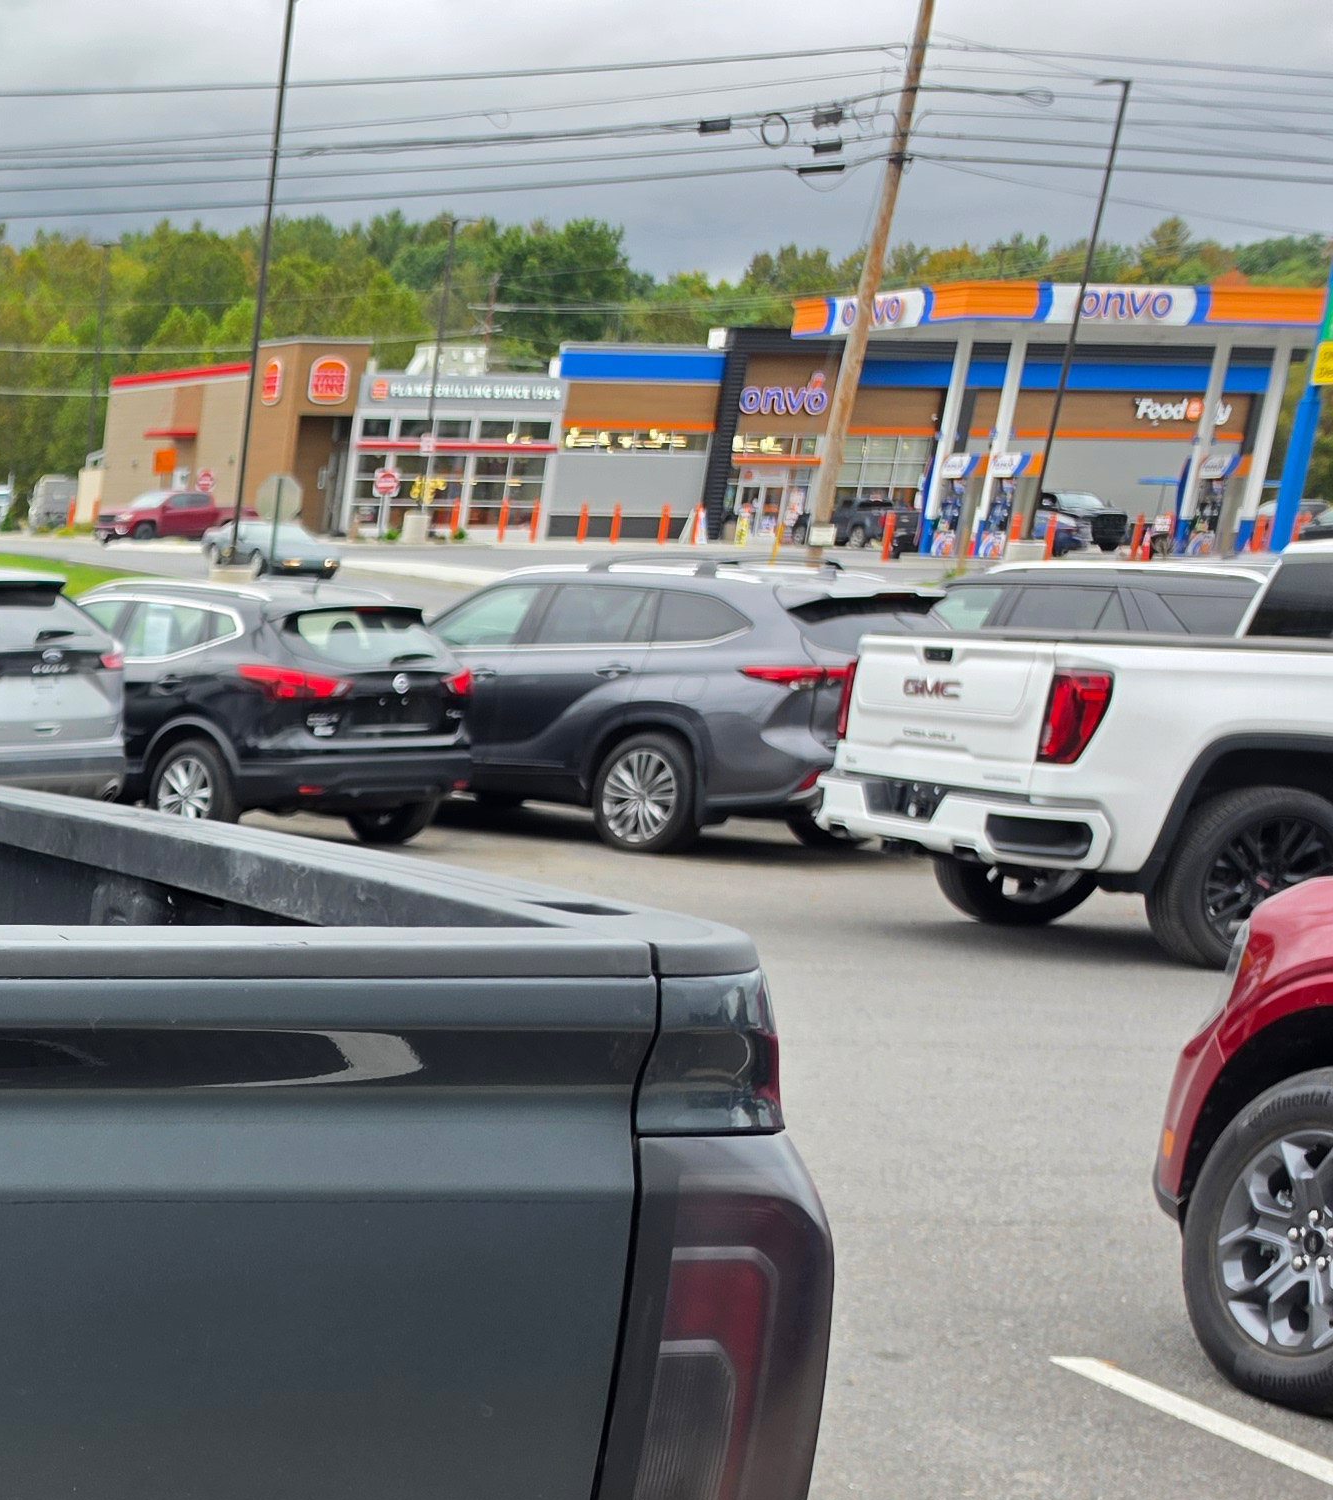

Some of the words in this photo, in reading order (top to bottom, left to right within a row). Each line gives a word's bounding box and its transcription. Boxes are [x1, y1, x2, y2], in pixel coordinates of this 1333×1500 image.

[842, 296, 901, 327] ovo
[1081, 289, 1174, 320] onvo
[493, 384, 530, 400] SINCE
[739, 385, 828, 415] onvo
[903, 678, 962, 699] GMC
